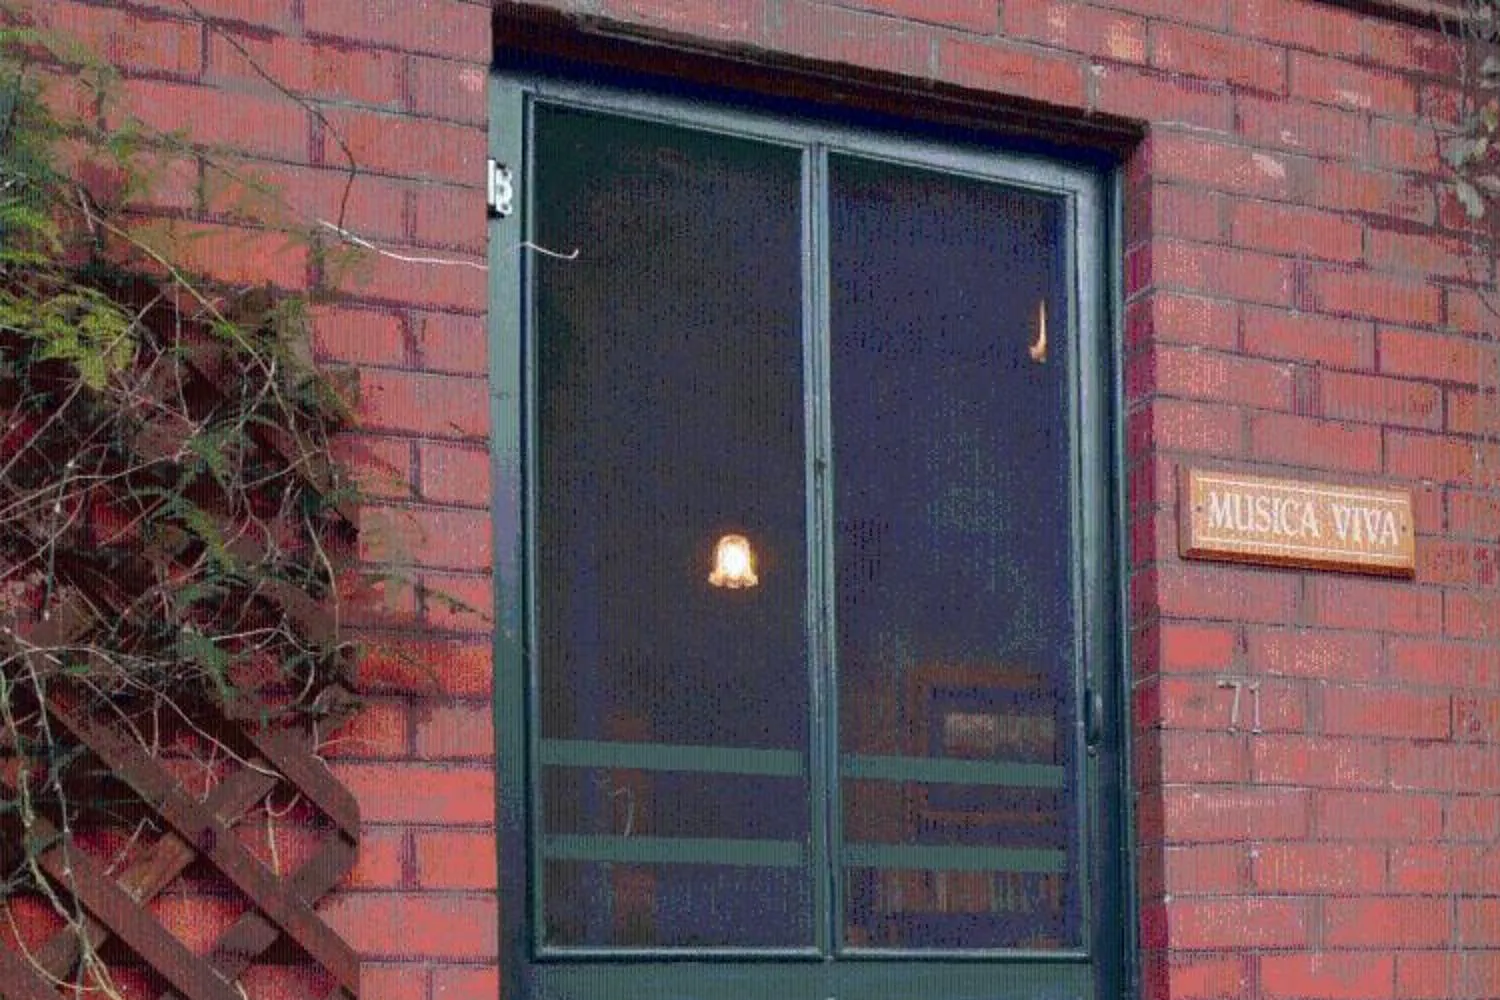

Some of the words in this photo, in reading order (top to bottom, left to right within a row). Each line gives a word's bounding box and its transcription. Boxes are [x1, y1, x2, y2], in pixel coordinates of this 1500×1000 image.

[1207, 491, 1320, 538] MUSICA
[1330, 502, 1400, 545] VIVA
[1216, 677, 1262, 735] 71
